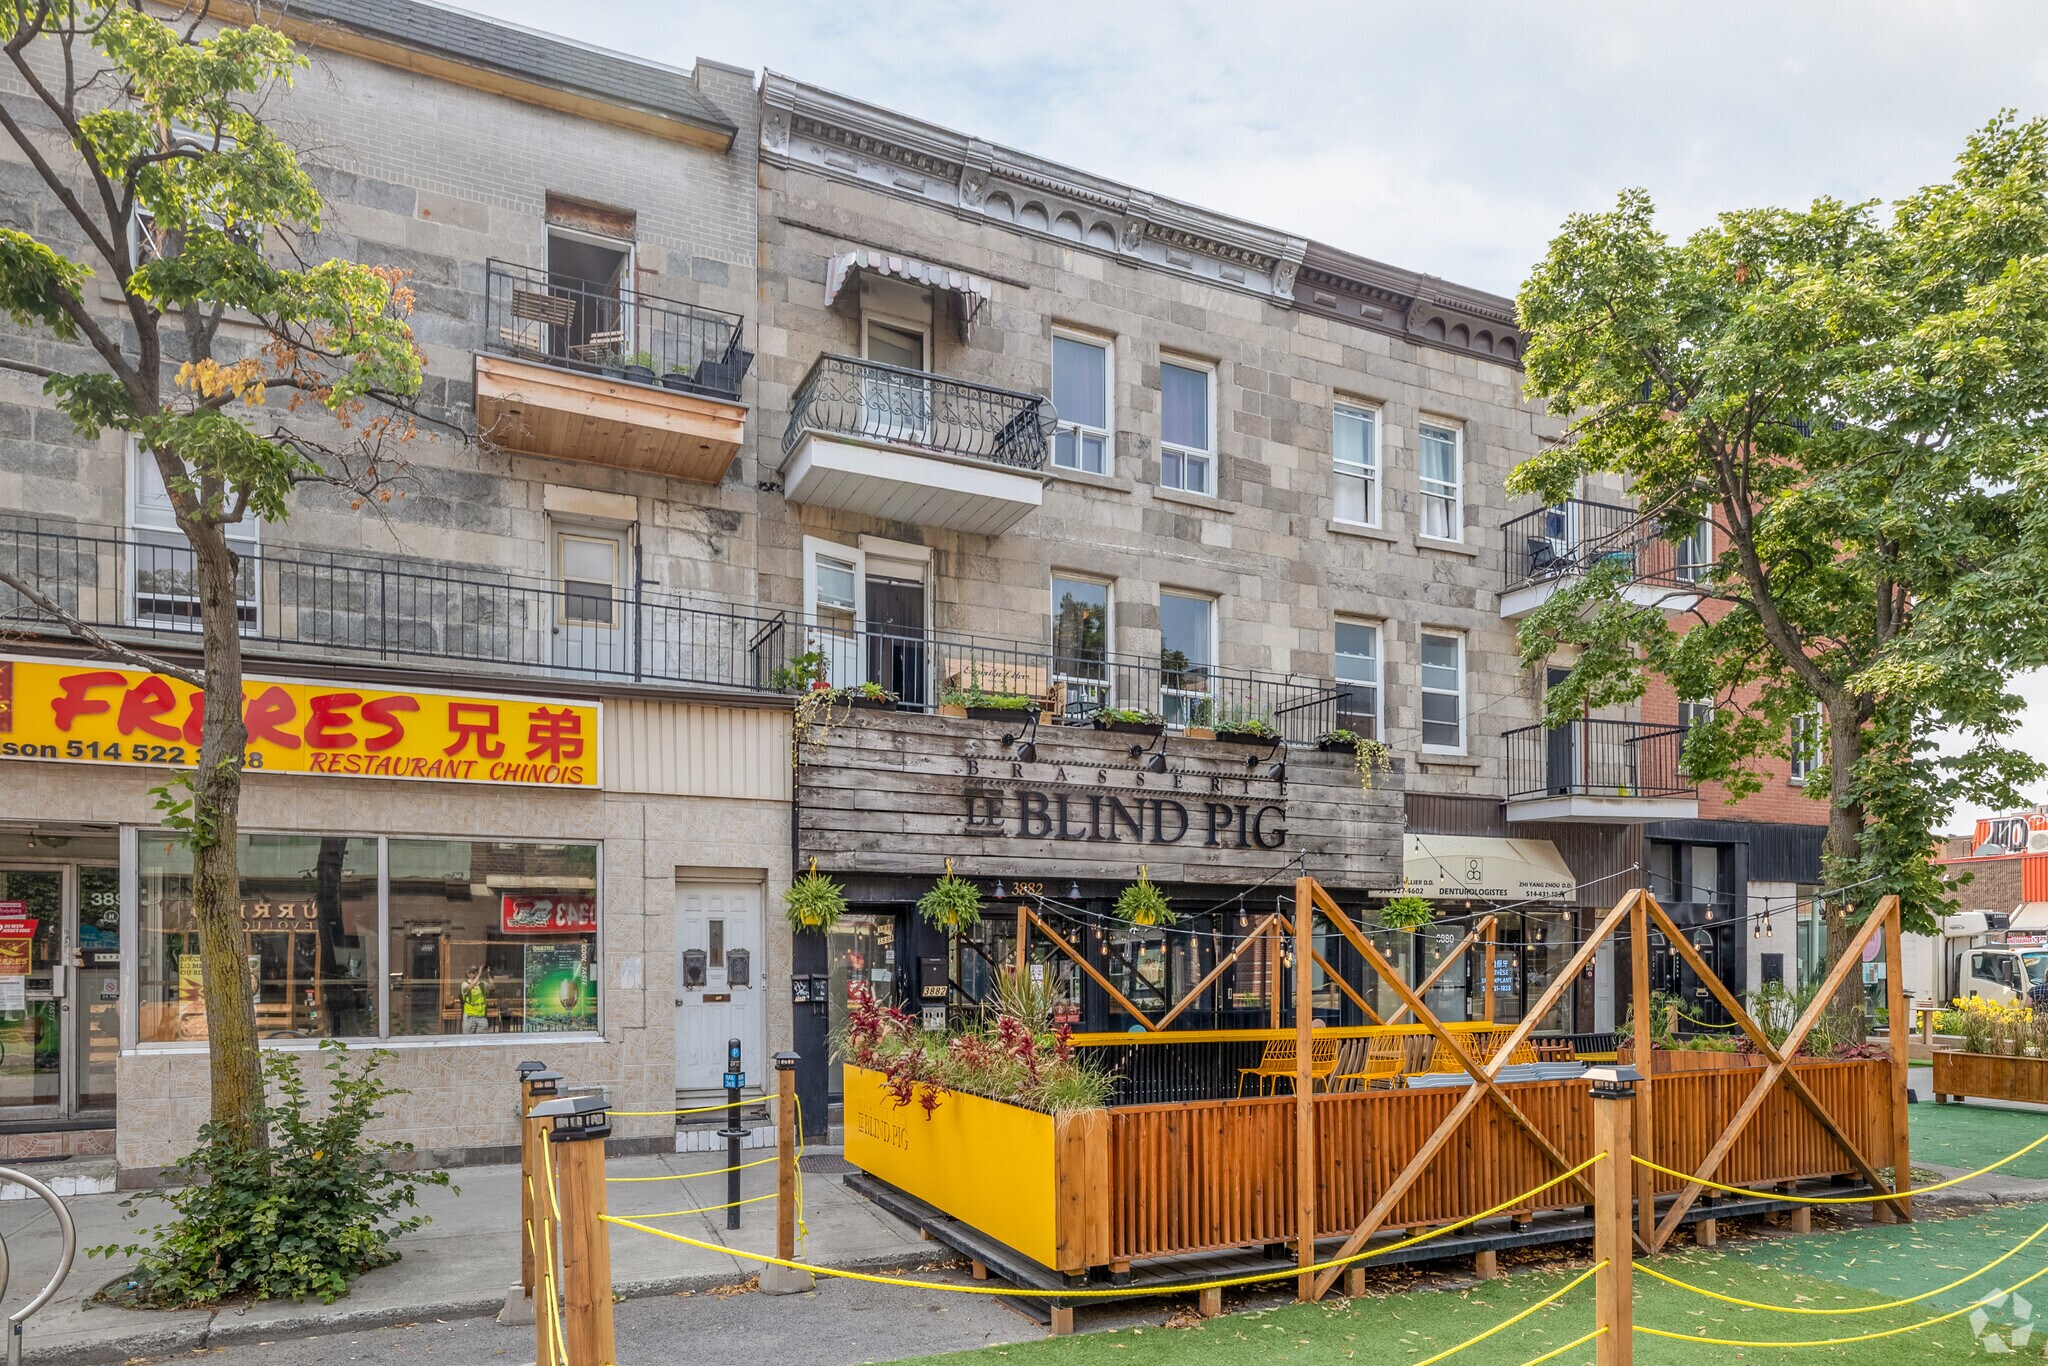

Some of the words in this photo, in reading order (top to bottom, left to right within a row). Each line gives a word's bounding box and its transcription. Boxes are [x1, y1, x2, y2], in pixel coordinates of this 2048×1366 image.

[443, 702, 584, 764] 兄弟
[66, 740, 122, 761] 514
[132, 744, 185, 764] 522
[309, 752, 478, 780] RESTAURANT
[489, 761, 583, 785] CHINOIS
[967, 758, 1288, 797] BRASSERIE
[1015, 790, 1189, 844] BLIND
[1204, 802, 1289, 849] PIG
[1012, 882, 1044, 896] 3882
[924, 986, 947, 996] 3882
[864, 1114, 891, 1143] BLIND
[892, 1124, 909, 1151] PIG
